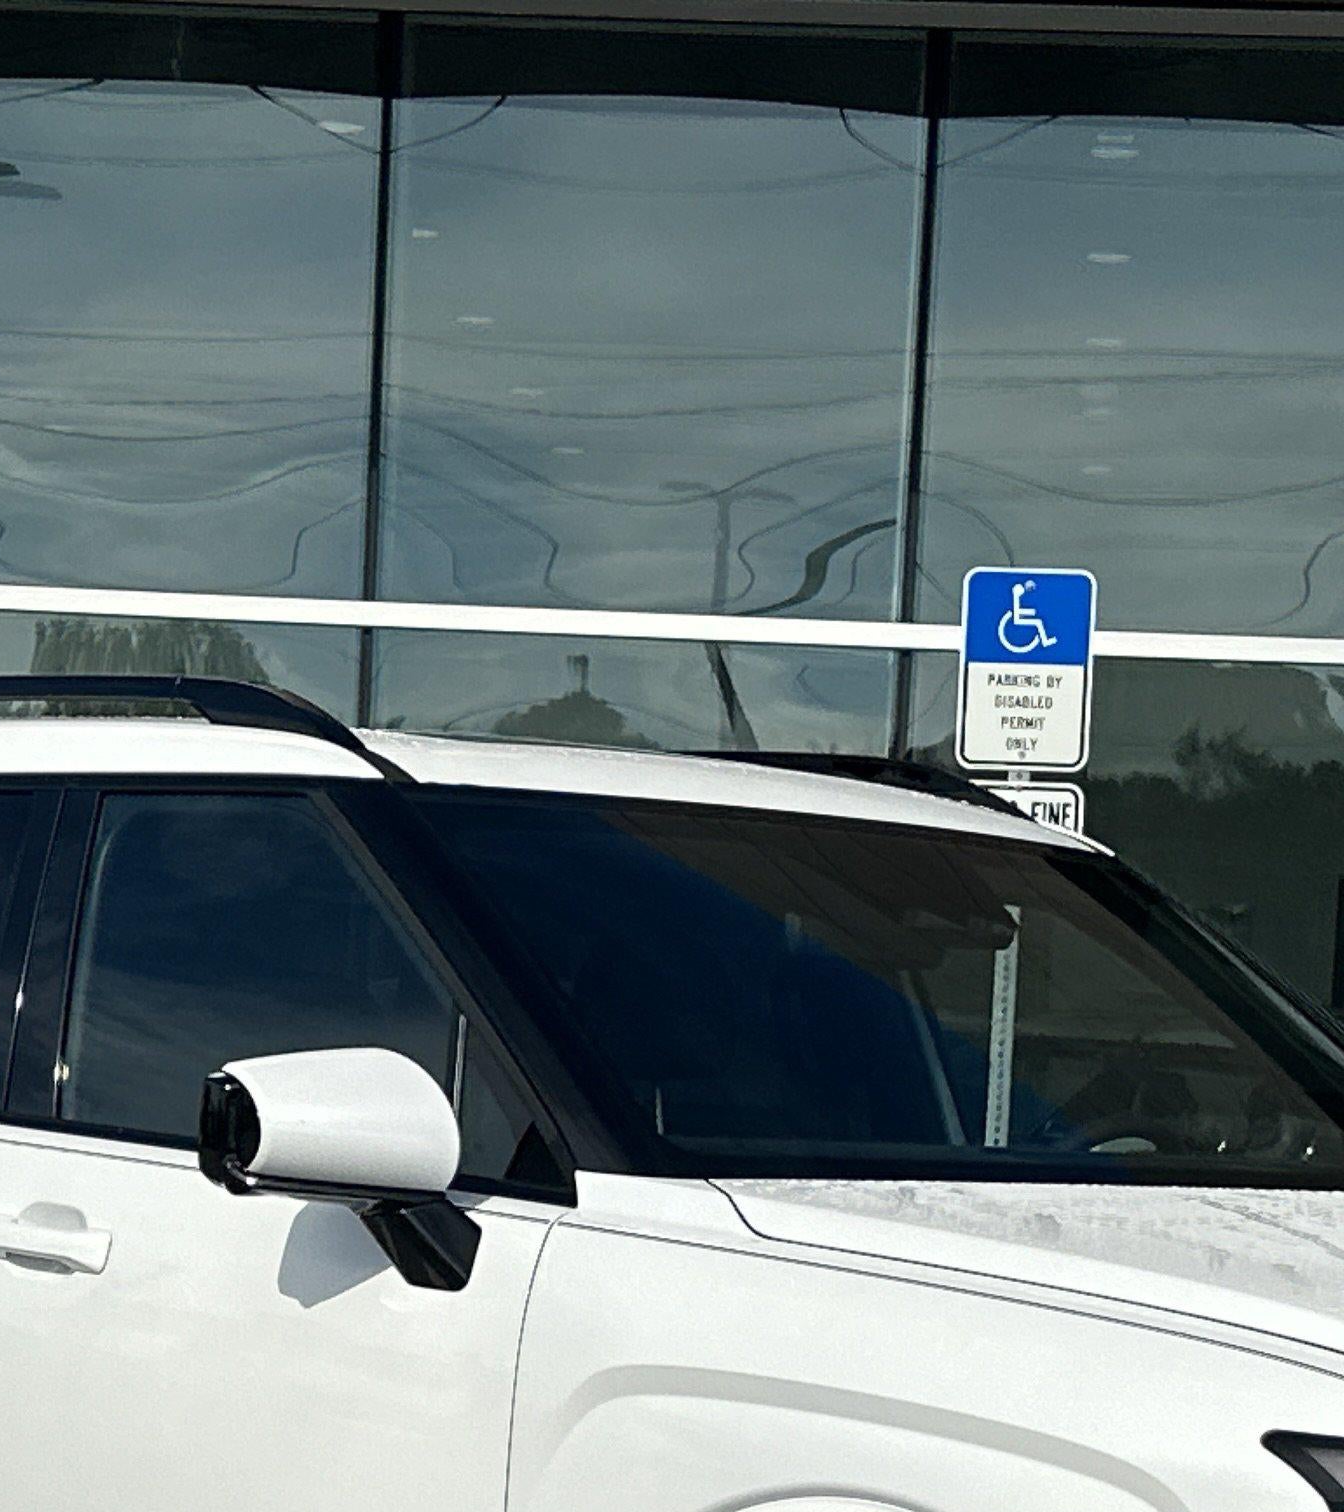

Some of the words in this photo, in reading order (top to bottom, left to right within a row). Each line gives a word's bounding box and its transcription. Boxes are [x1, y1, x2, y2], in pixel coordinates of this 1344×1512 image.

[987, 674, 1040, 687] PARKING
[1046, 676, 1063, 689] BY
[994, 694, 1053, 709] DISABLED
[1001, 716, 1046, 731] PERMIT
[1006, 737, 1038, 751] ONLY
[1030, 801, 1072, 830] FINE
